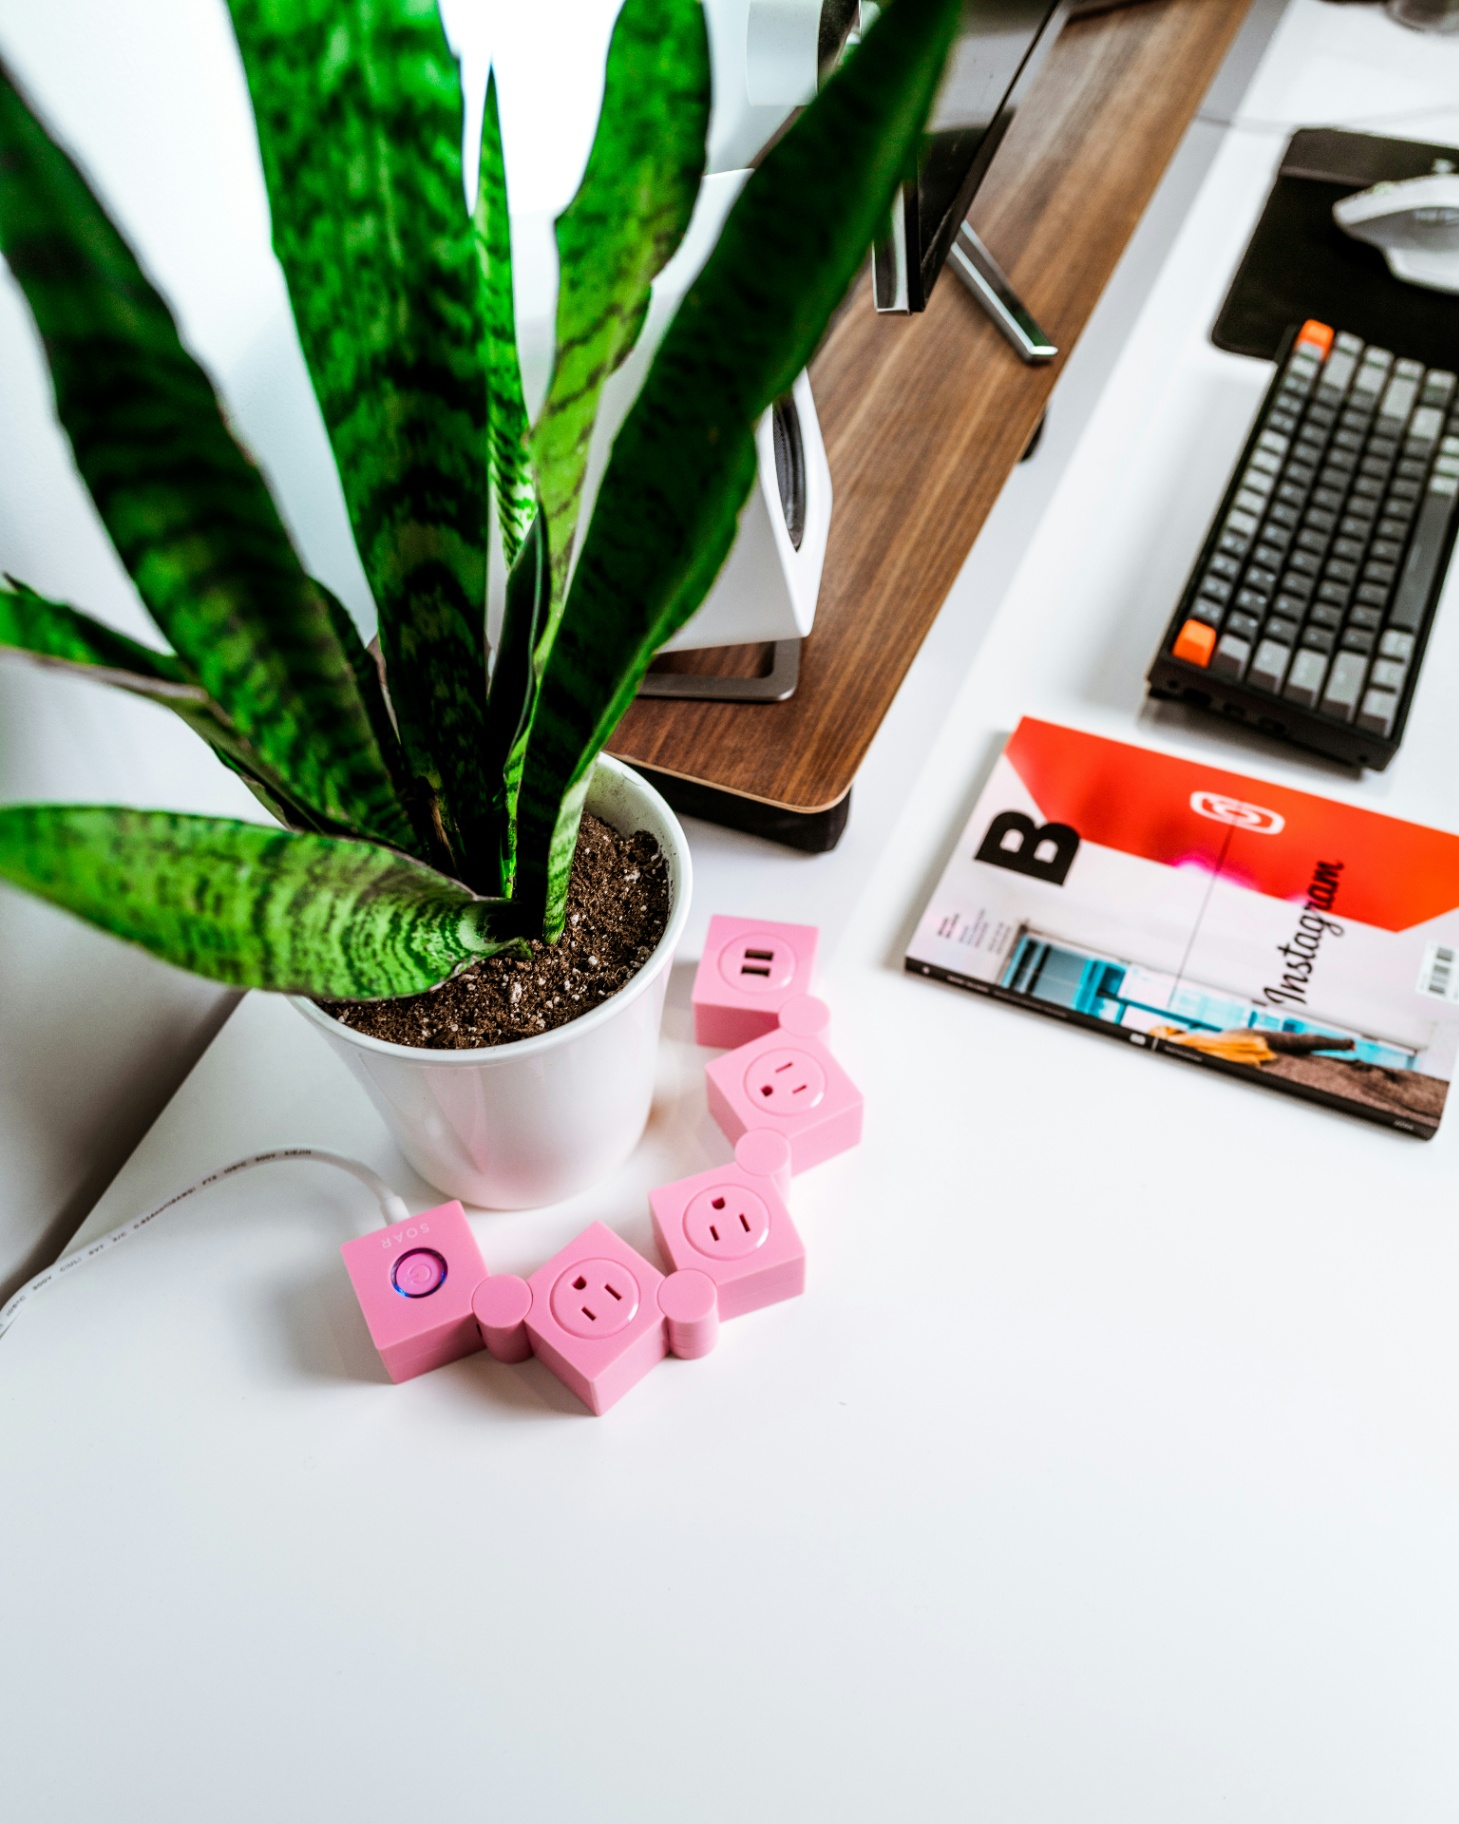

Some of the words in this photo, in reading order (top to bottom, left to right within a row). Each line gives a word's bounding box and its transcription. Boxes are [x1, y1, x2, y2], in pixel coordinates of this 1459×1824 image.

[973, 809, 1081, 887] B
[1264, 860, 1345, 1006] Instagram
[381, 1223, 430, 1249] SOAR
